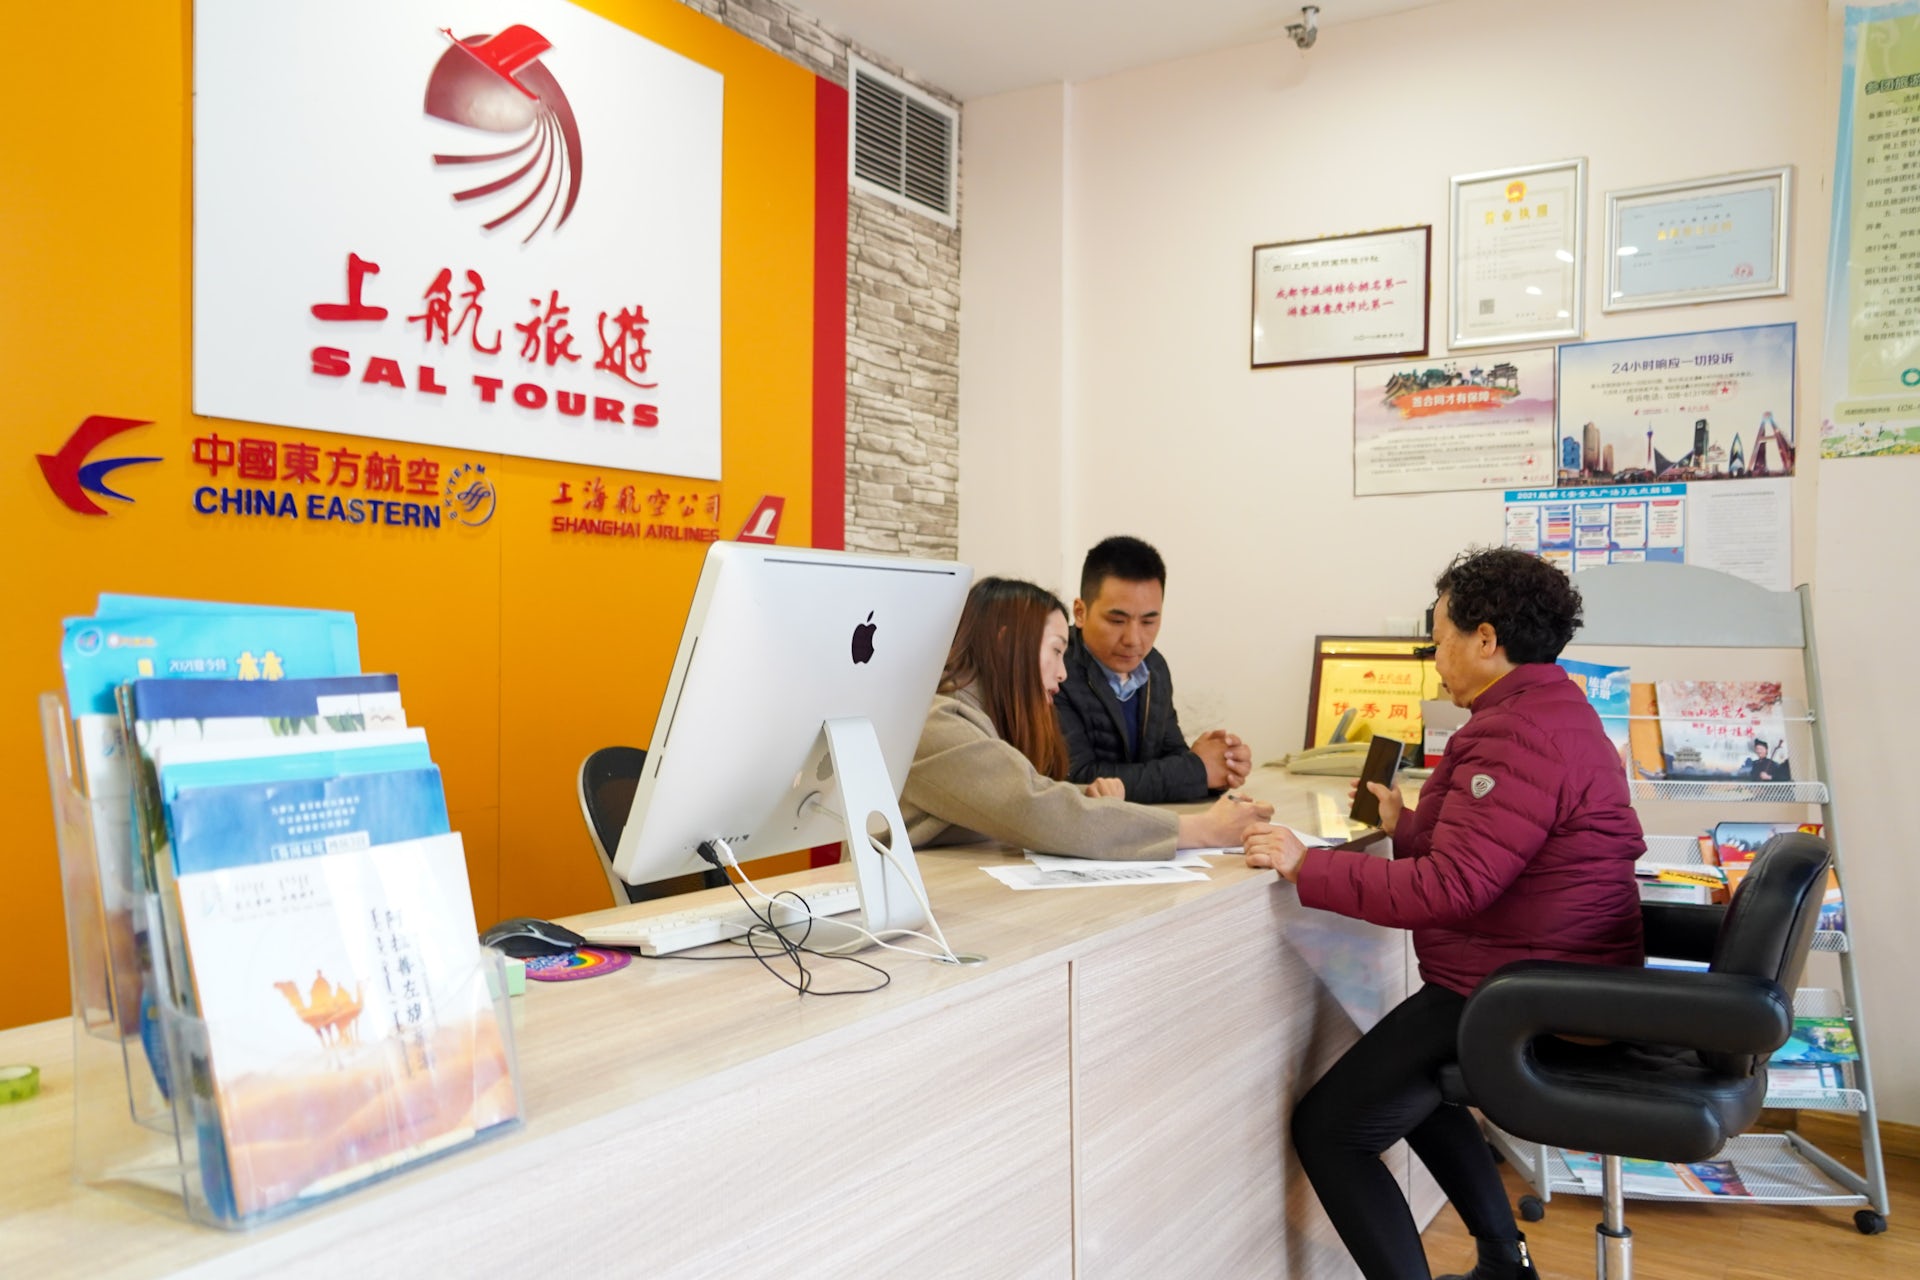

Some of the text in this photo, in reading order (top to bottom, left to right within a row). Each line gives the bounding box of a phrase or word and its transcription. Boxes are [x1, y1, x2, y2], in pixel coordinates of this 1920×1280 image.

[1612, 352, 1735, 375] 24小时响应一切投诉
[311, 346, 659, 428] SAL TOURS
[1411, 391, 1491, 409] 签合同才有保障
[192, 432, 440, 497] 中國東方航空
[193, 486, 441, 528] CHINA EASTERN
[551, 477, 720, 523] 上海航空公司
[552, 516, 720, 543] SHANGHAI AIRLINES
[1333, 702, 1424, 720] 优秀网
